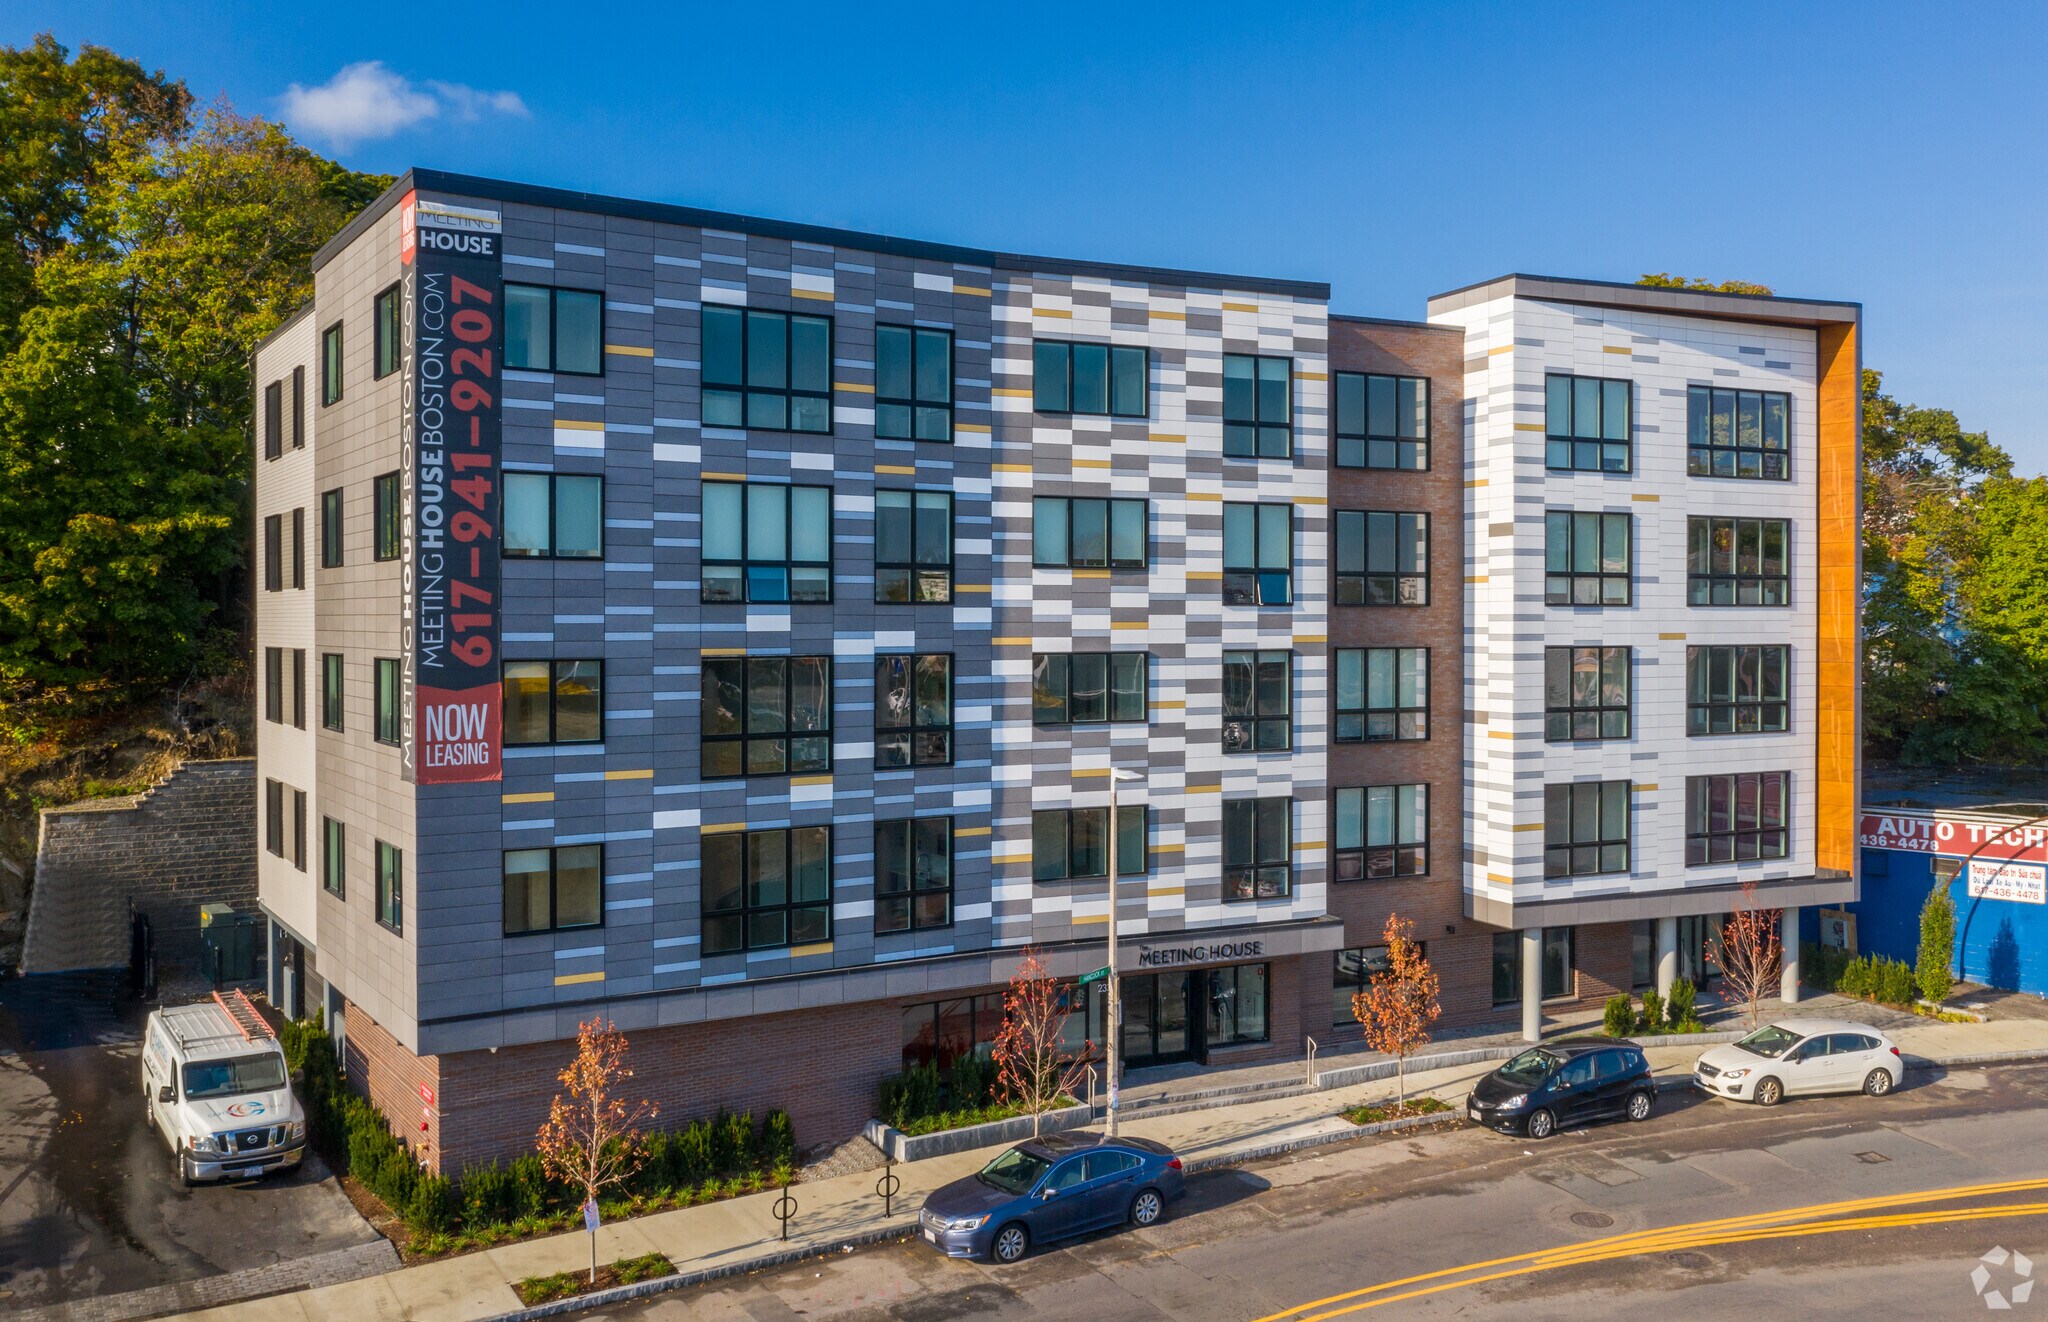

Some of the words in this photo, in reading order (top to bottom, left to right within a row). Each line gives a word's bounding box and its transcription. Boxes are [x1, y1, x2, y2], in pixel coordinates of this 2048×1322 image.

[420, 230, 494, 255] HOUSE
[426, 703, 488, 742] NOW
[426, 742, 489, 767] LEASING
[1877, 817, 1955, 841] AUTO
[1965, 824, 2045, 849] TECH
[1974, 885, 2040, 900] 617-436-4478
[1139, 946, 1205, 966] MEETING
[1210, 941, 1261, 958] HOUSE
